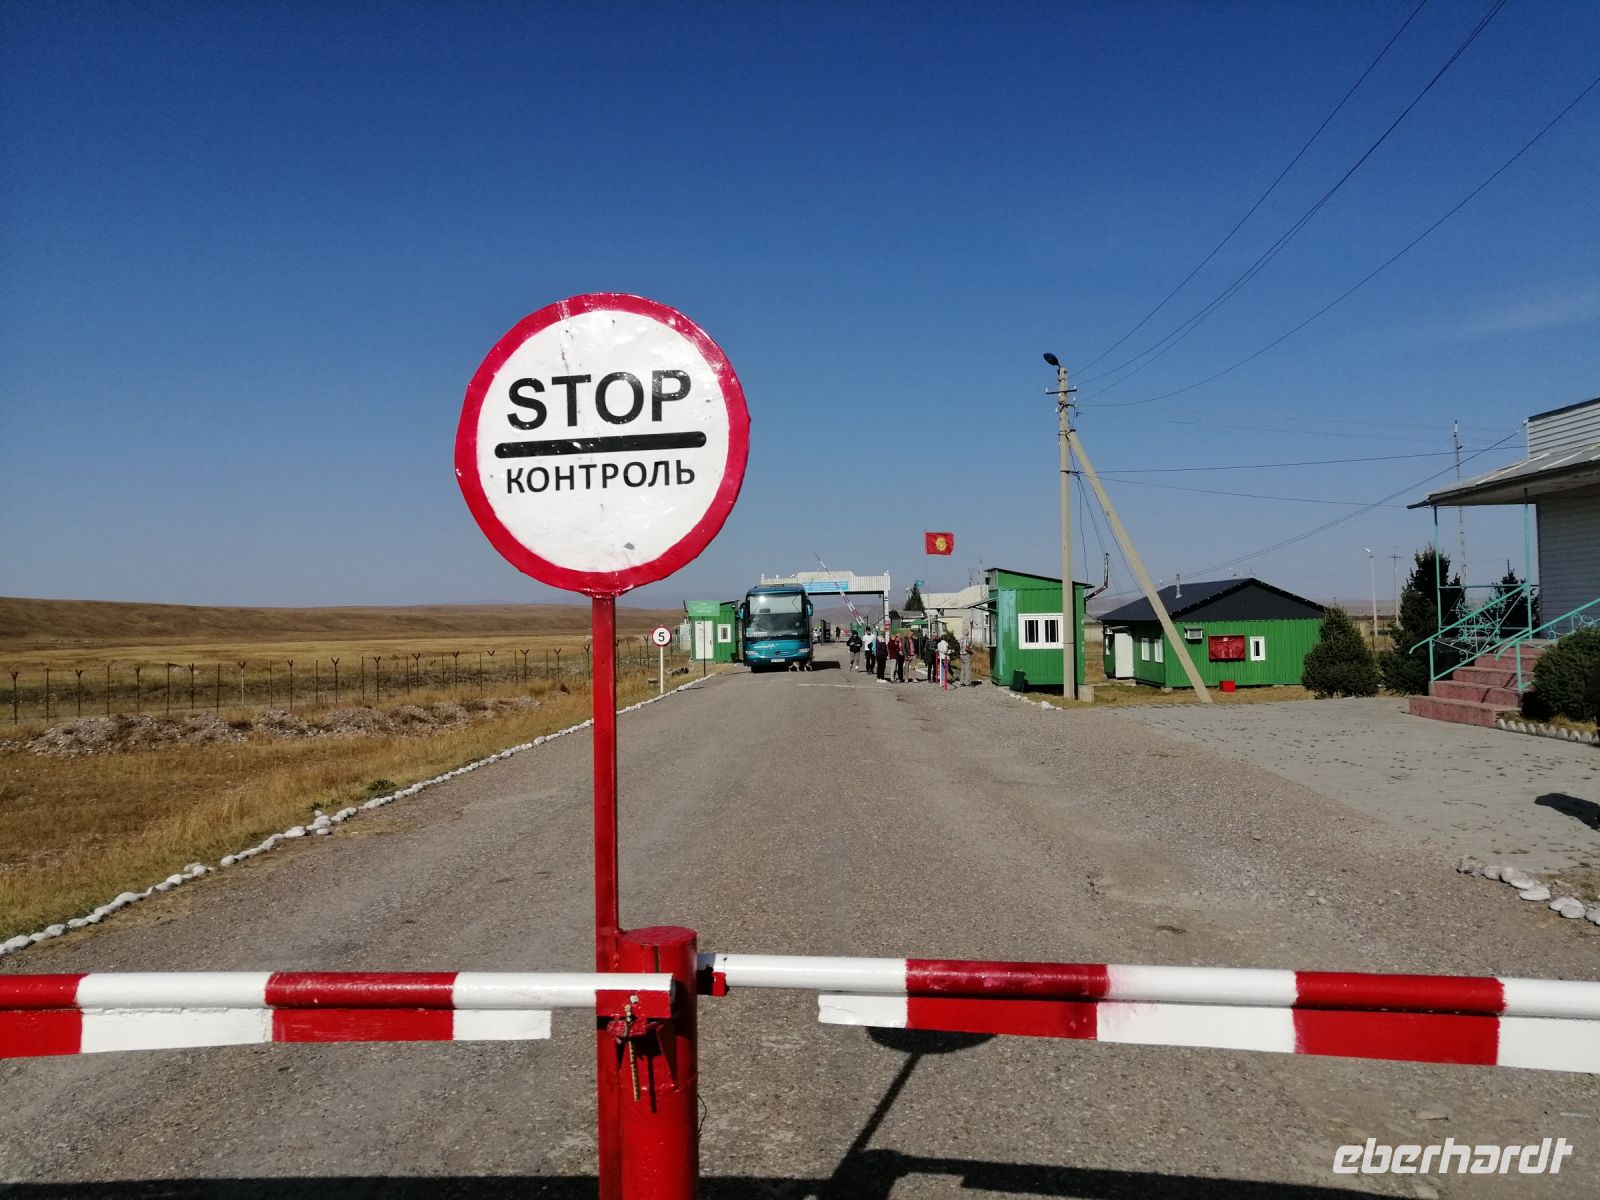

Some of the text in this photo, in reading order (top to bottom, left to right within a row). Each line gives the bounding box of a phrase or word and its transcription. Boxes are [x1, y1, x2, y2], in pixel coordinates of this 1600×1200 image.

[506, 369, 692, 431] STOP
[506, 459, 696, 494] КОНТРОЛЬ
[658, 631, 665, 642] 5
